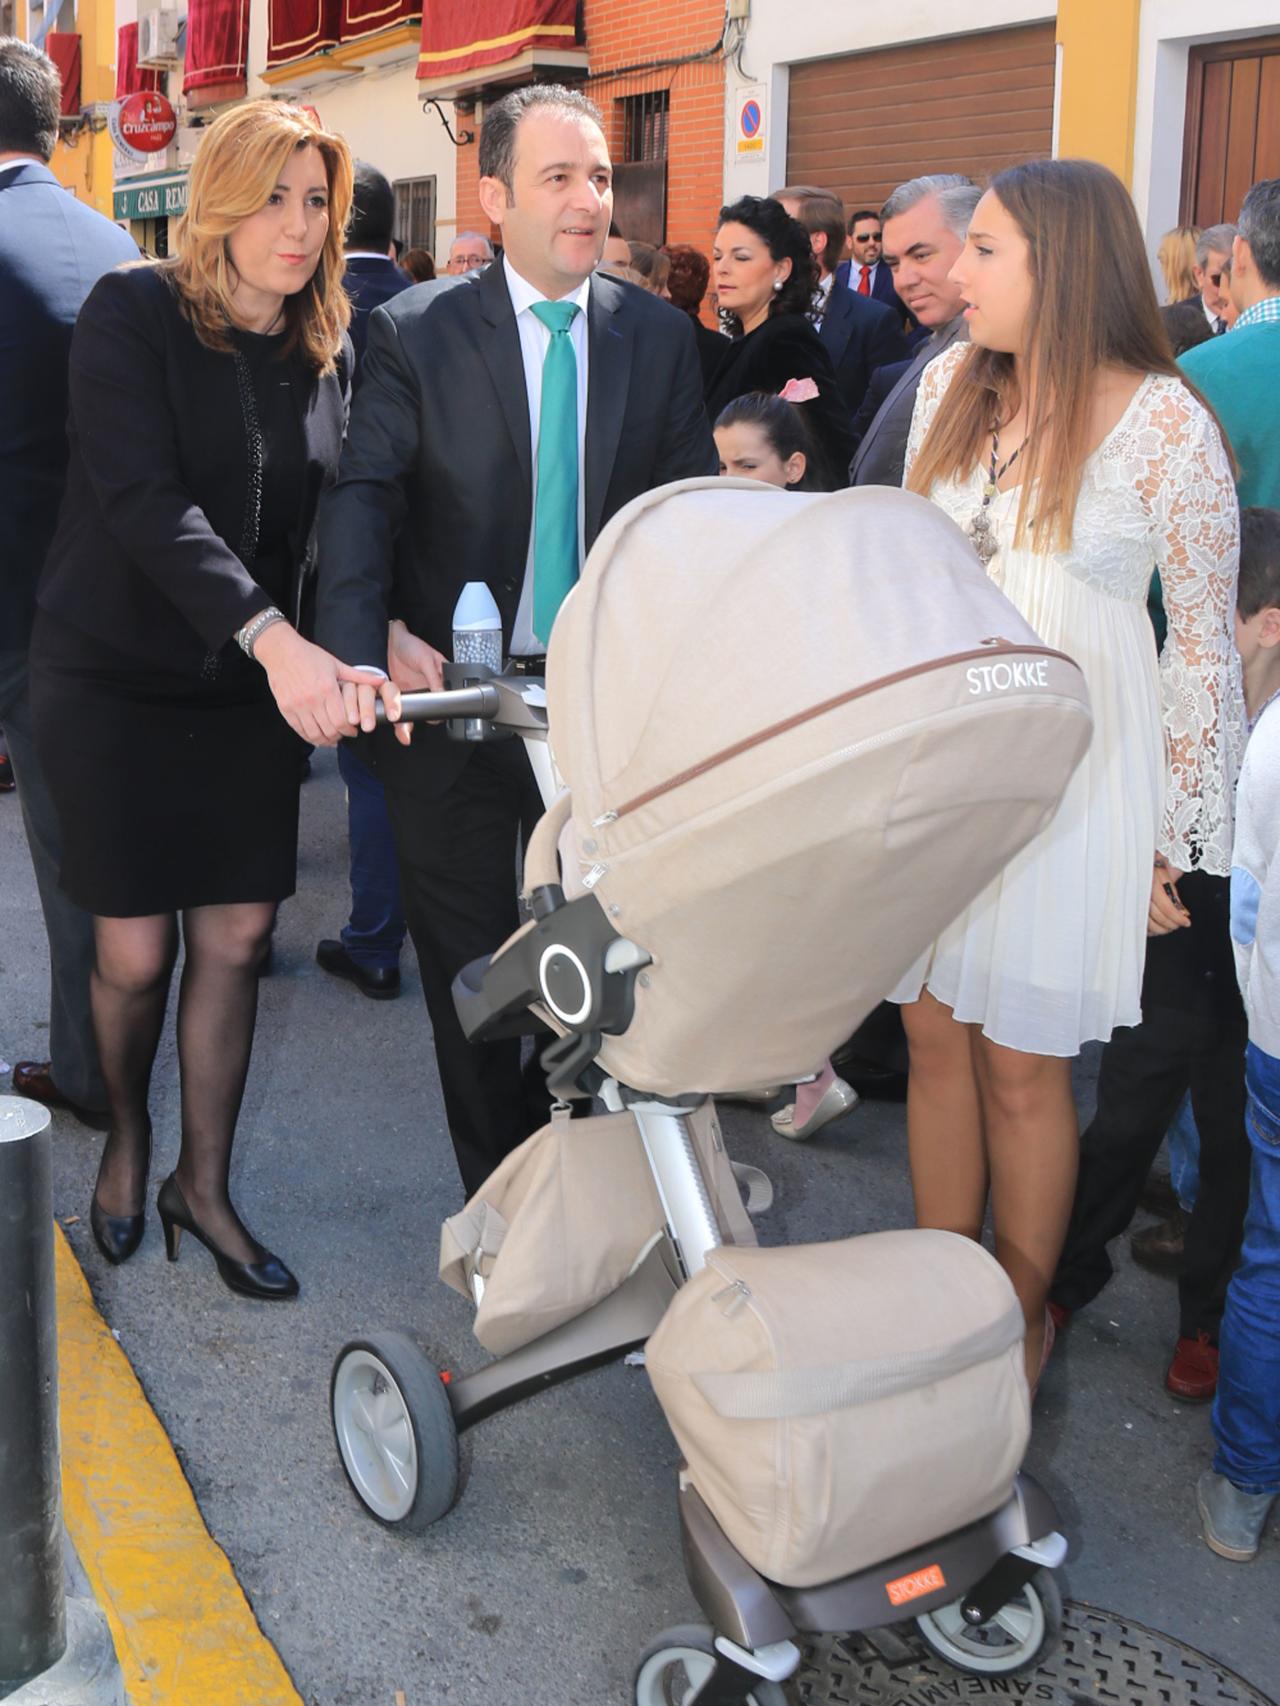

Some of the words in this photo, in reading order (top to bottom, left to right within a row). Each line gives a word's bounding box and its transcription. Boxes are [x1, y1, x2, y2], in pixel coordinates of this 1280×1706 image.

[137, 189, 159, 213] CASA
[966, 660, 1048, 695] STOKKE
[889, 1568, 942, 1602] STOKKE
